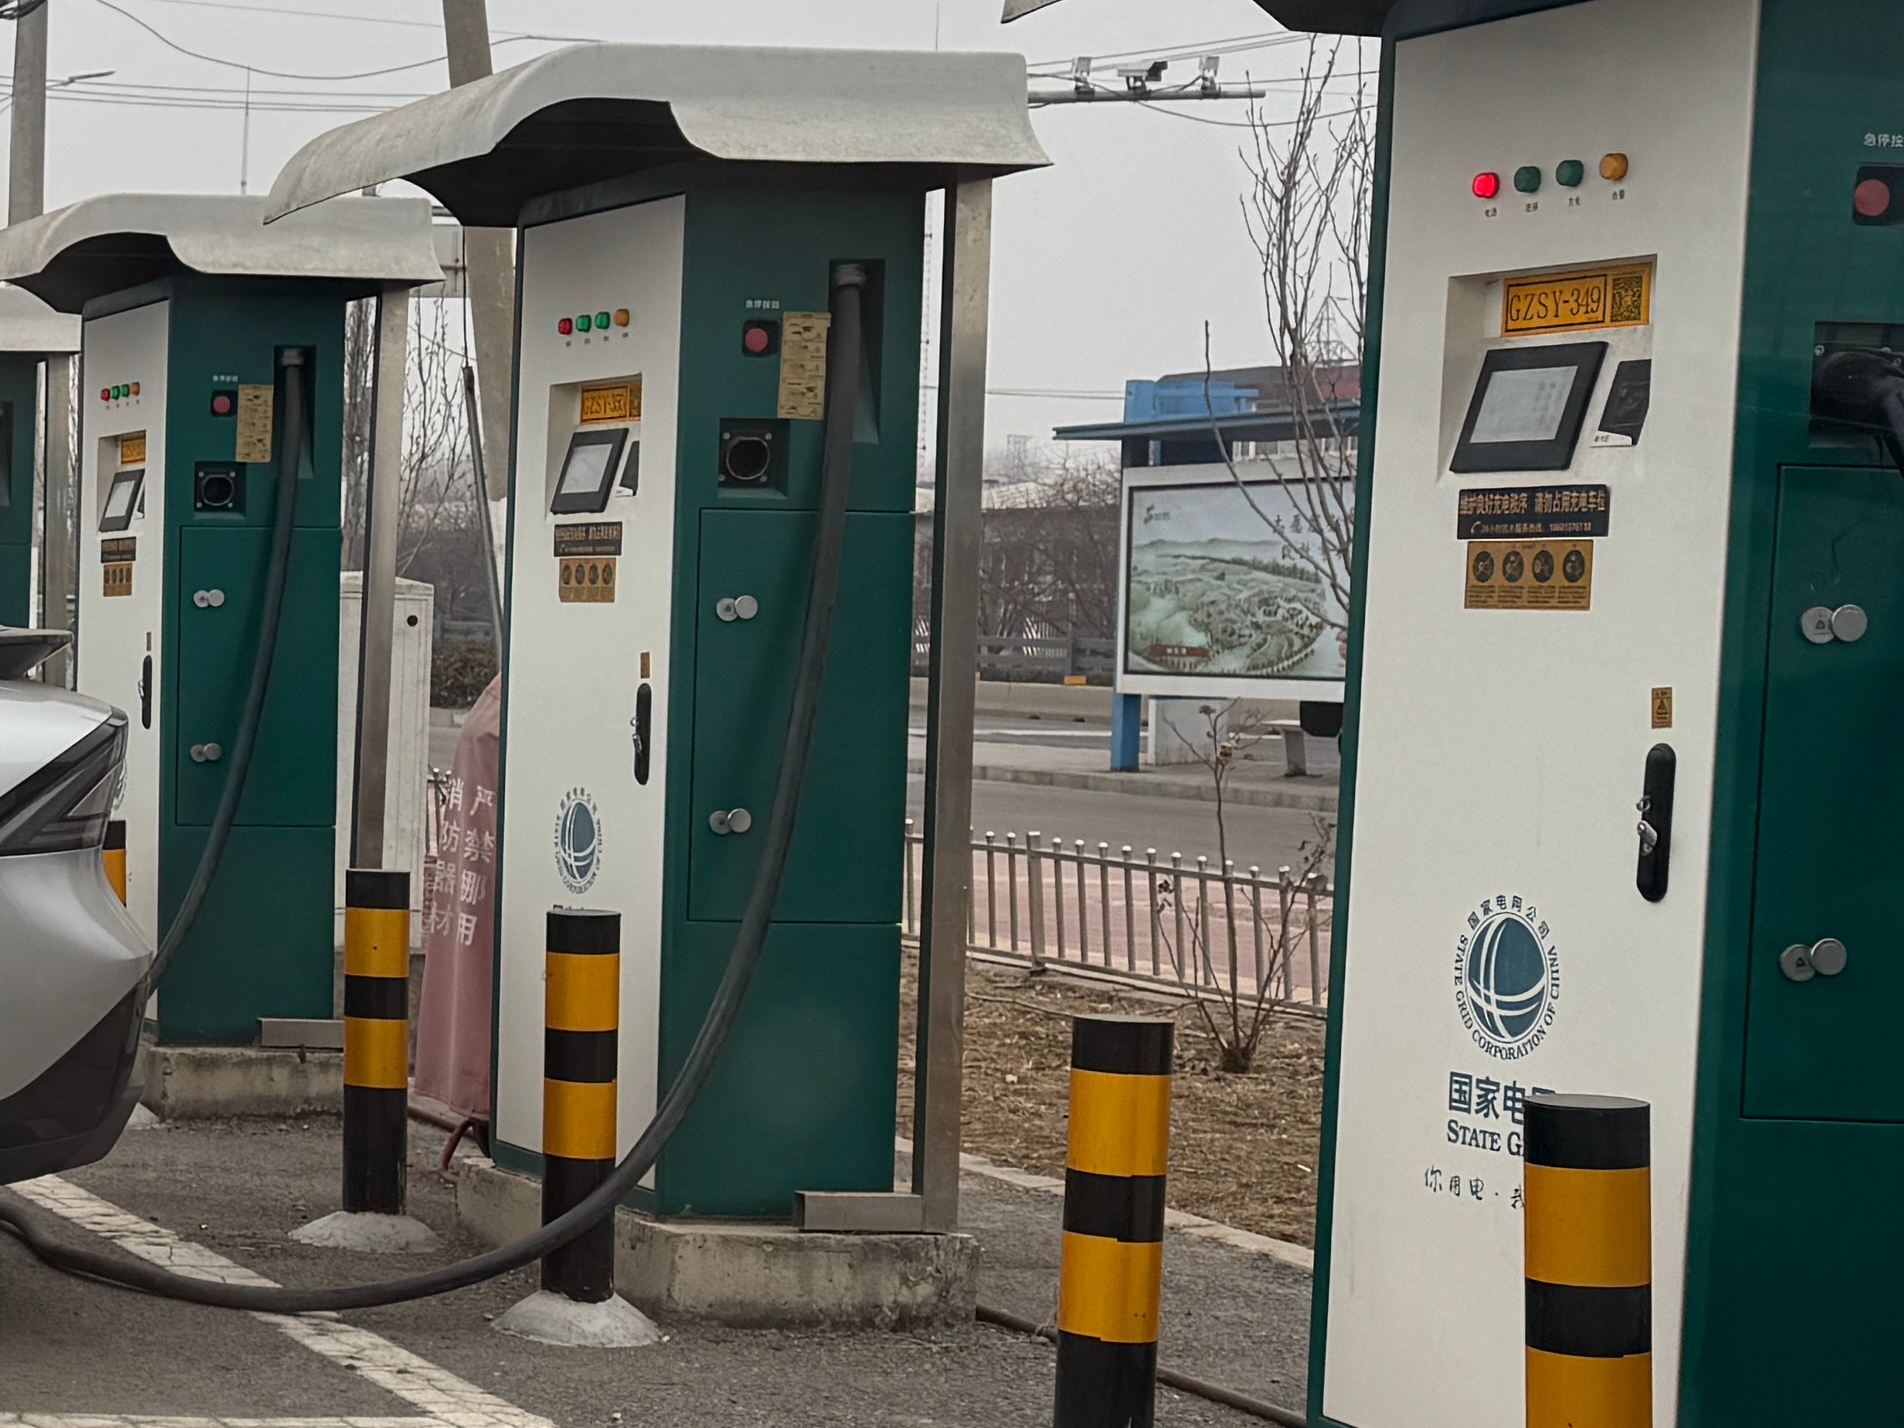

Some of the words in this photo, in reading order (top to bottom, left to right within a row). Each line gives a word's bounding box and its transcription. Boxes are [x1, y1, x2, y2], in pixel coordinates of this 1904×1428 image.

[1509, 285, 1601, 322] GZSY-349
[430, 777, 464, 938] 消防器材
[456, 785, 496, 947] 严禁挪用
[1467, 894, 1551, 940] 国家电网公司
[1454, 934, 1469, 986] STATE
[1547, 945, 1560, 1001] CHINA
[1455, 990, 1473, 1030] GRID
[1545, 1002, 1556, 1026] OF
[1472, 1025, 1547, 1061] CORPORATION
[1449, 1071, 1555, 1125] 国家电
[1447, 1119, 1502, 1152] STATE
[1507, 1131, 1525, 1157] G
